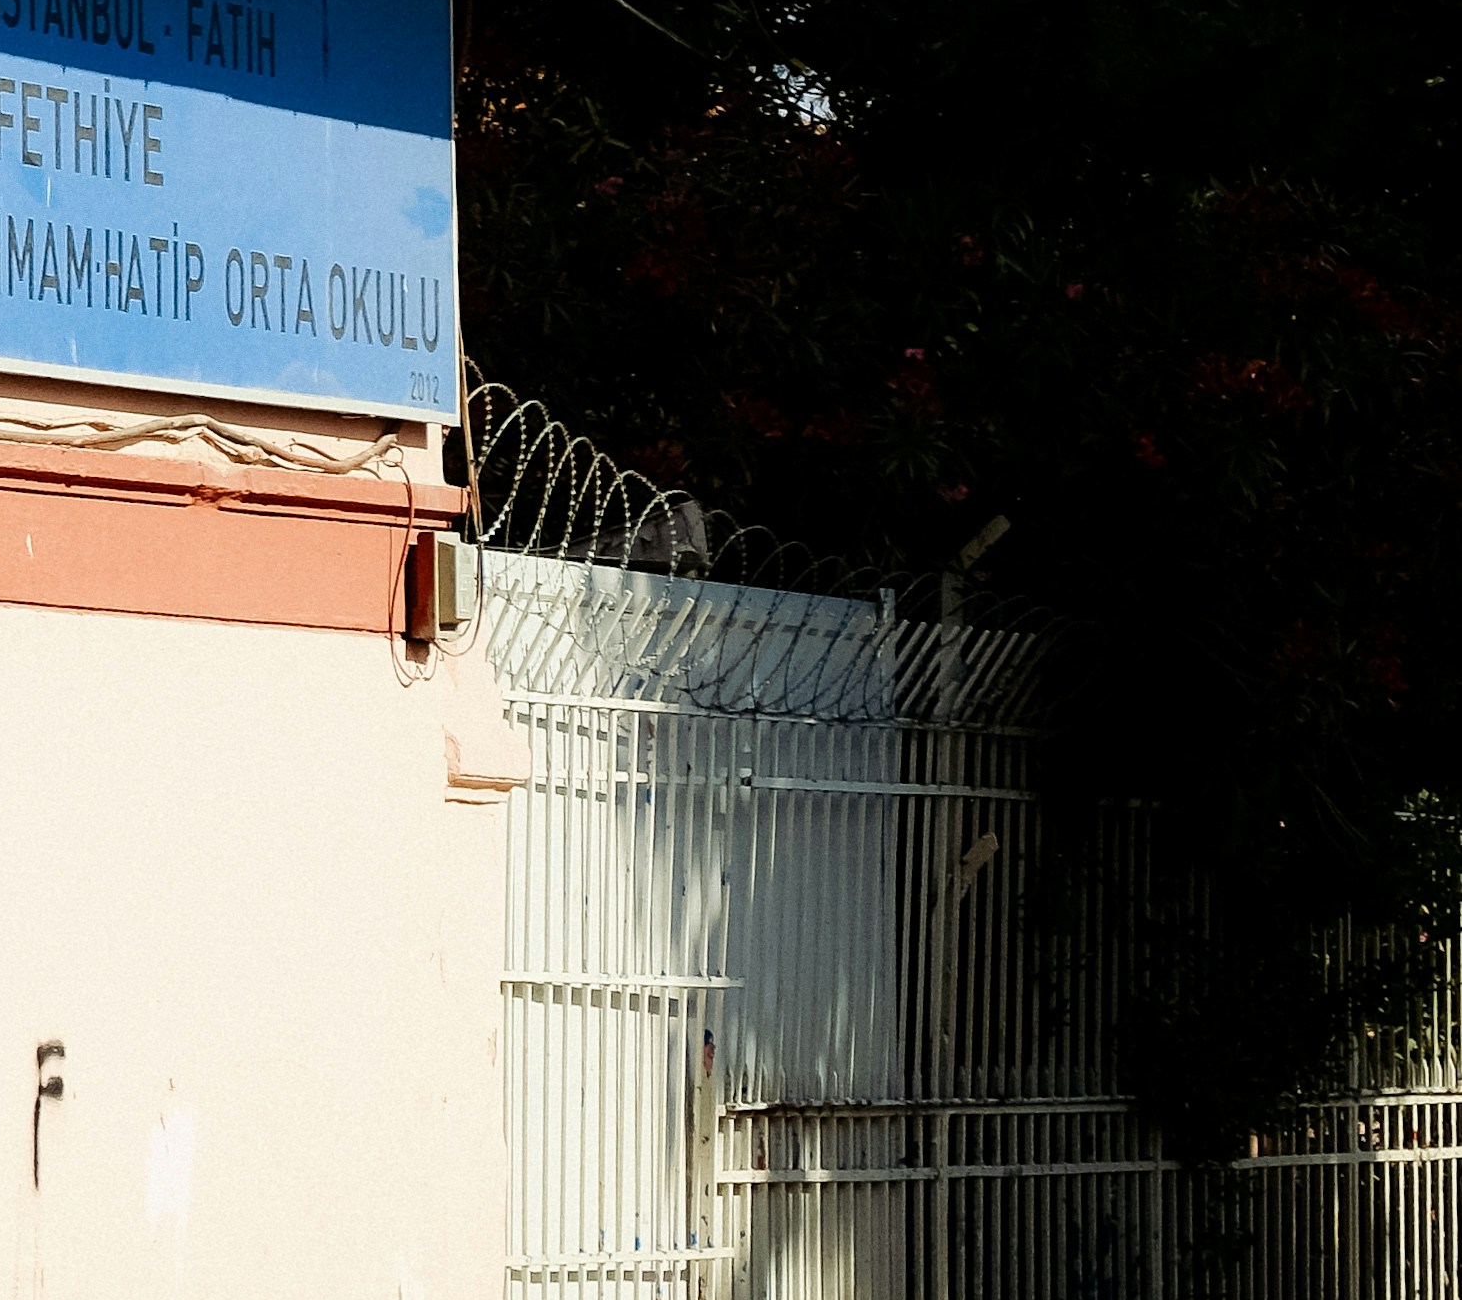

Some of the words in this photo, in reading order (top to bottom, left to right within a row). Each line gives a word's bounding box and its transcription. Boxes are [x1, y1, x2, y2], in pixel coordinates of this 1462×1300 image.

[225, 248, 317, 337] ORTA
[329, 263, 440, 353] OKULU
[410, 371, 440, 405] 2012
